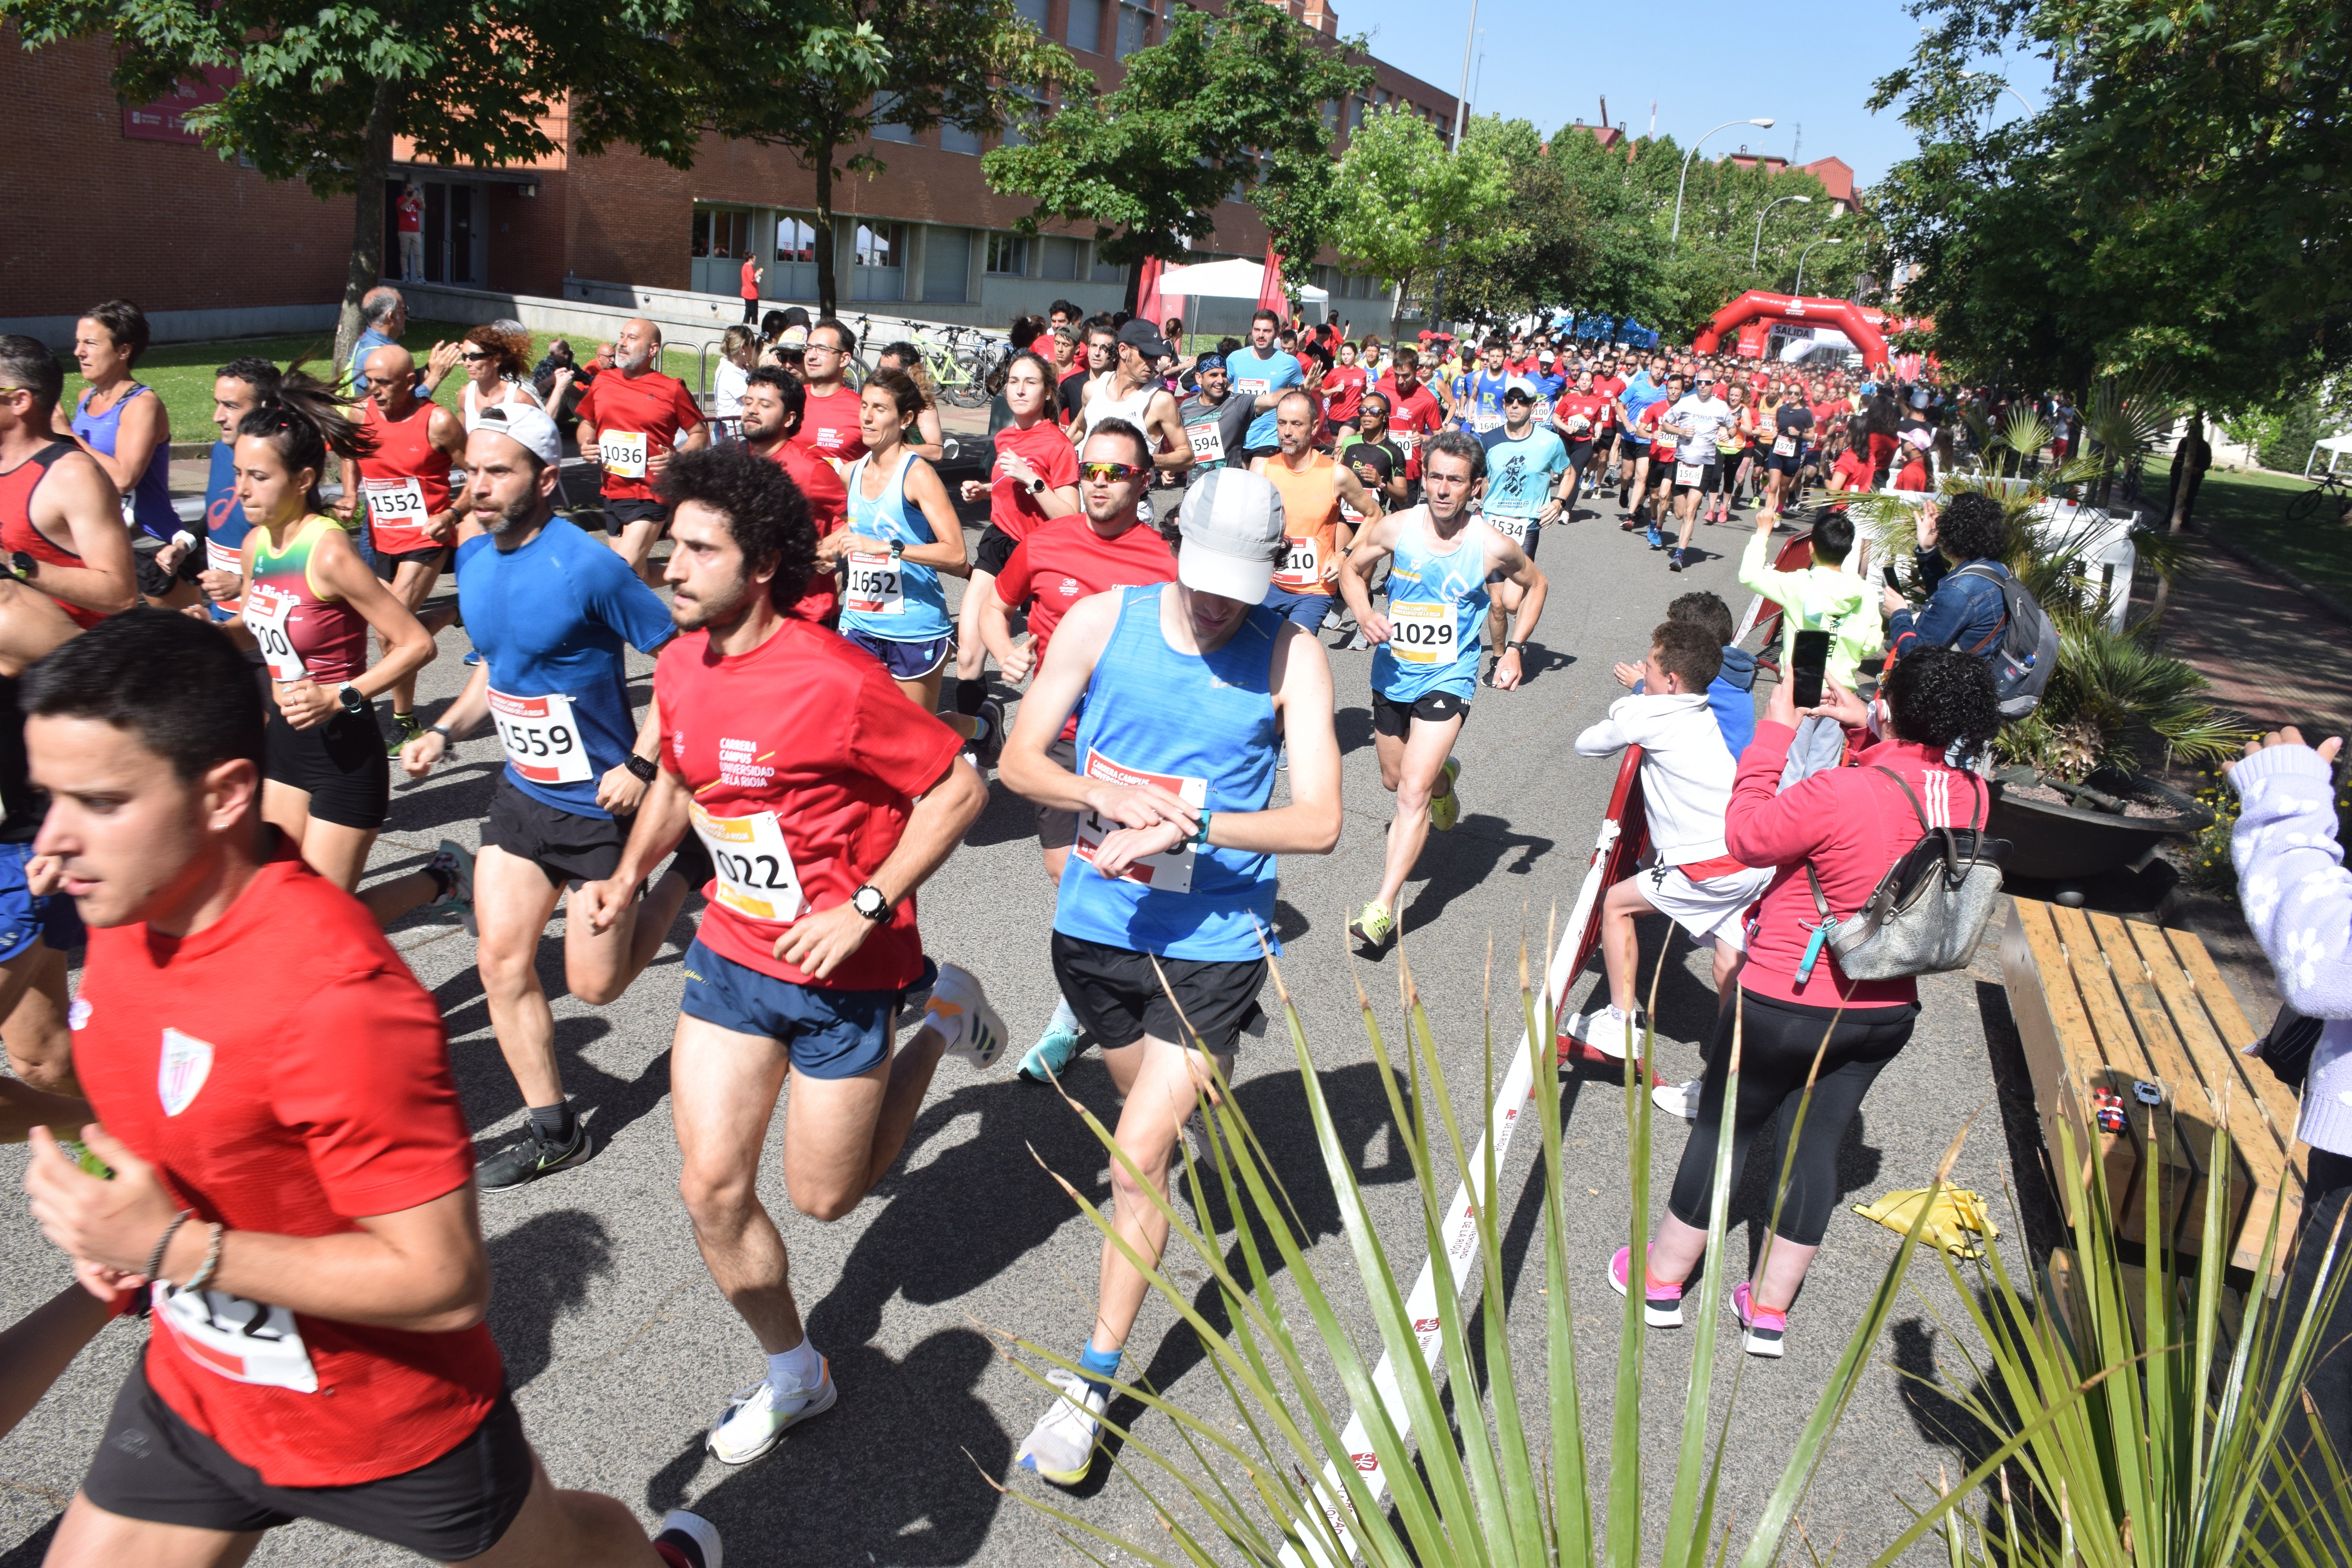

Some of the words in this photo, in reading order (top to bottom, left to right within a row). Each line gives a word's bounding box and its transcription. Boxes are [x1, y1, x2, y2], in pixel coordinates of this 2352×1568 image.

[1775, 325, 1809, 338] SALIDA
[1570, 419, 1588, 429] 1045
[604, 445, 642, 463] 1036
[1777, 442, 1793, 450] 1574
[1679, 470, 1700, 479] 1568
[372, 493, 421, 512] 1552
[1491, 519, 1523, 537] 1534
[852, 570, 898, 593] 1652
[1394, 622, 1452, 645] 1029
[499, 721, 573, 757] 1559
[720, 737, 757, 753] CARRERA
[719, 749, 752, 765] CAMPUS
[719, 761, 775, 777] UNIVERSIDAD
[1093, 760, 1118, 779] CARRERA
[1118, 773, 1150, 785] CAMPUS
[721, 772, 730, 784] DE
[730, 774, 740, 786] LA
[740, 777, 768, 788] RIOJA
[1494, 1137, 1507, 1152] RIOJA
[1450, 1239, 1465, 1255] RIOJA
